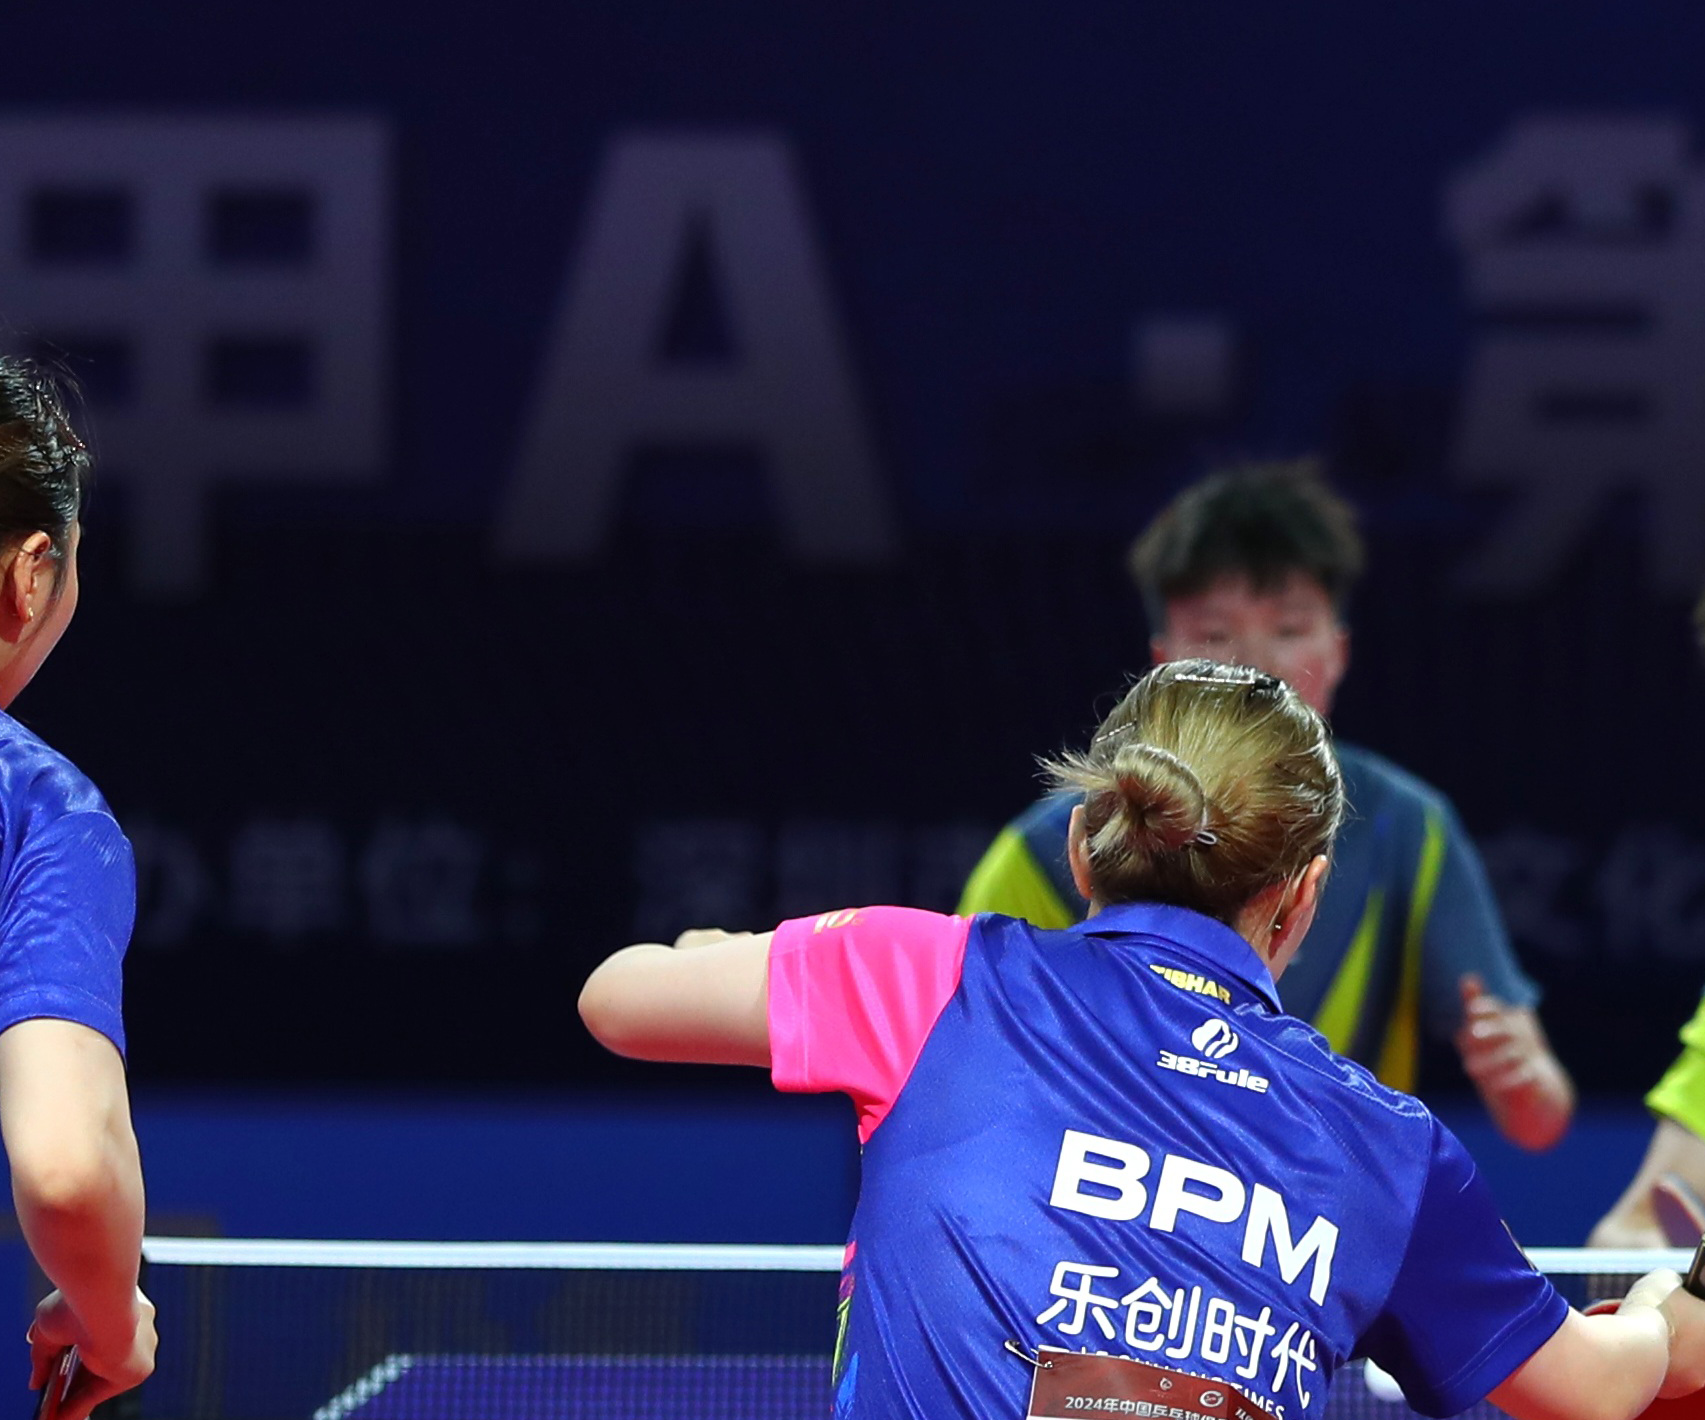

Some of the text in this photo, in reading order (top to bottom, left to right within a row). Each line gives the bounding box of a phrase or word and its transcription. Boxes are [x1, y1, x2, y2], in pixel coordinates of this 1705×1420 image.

[1156, 1049, 1270, 1094] 38Fule
[1049, 1129, 1341, 1307] BPM
[1036, 1260, 1319, 1409] 乐创时代
